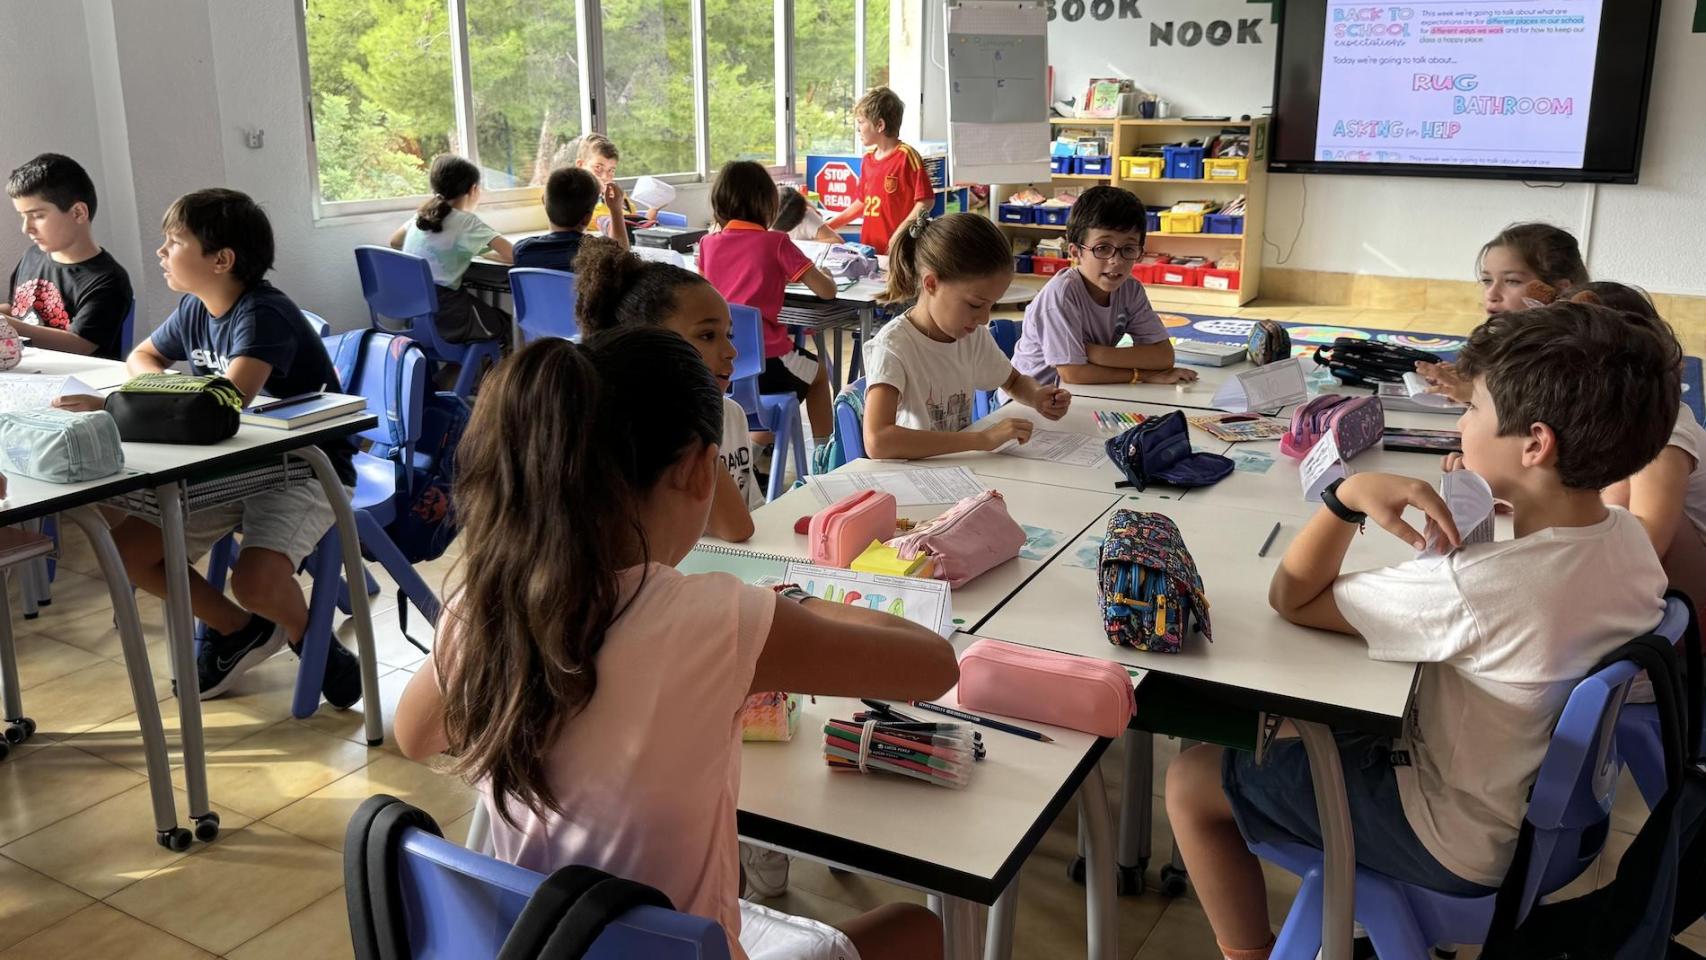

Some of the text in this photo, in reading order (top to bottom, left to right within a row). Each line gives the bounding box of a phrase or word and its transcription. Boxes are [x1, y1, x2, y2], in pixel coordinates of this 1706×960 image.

[1333, 7, 1414, 21] BACK TO
[1422, 9, 1436, 17] This
[1455, 9, 1473, 17] we're
[1474, 9, 1494, 18] going
[1486, 17, 1514, 25] different
[1561, 16, 1584, 24] school
[1150, 18, 1263, 47] NOOK
[1334, 23, 1411, 38] SCHOOL
[1555, 26, 1572, 34] keep
[1334, 39, 1406, 47] expectations
[1443, 36, 1464, 44] happy
[1333, 56, 1355, 65] Today
[1357, 56, 1378, 64] we're
[1379, 57, 1402, 66] going
[1412, 73, 1479, 92] RUG
[1453, 95, 1573, 117] BATHROOM
[1333, 120, 1405, 138] ASKING
[1421, 121, 1461, 139] HELP
[1322, 149, 1401, 162] BACK TO
[824, 168, 850, 180] STOP
[828, 183, 847, 193] AND
[824, 195, 851, 207] READ
[863, 195, 881, 217] 22
